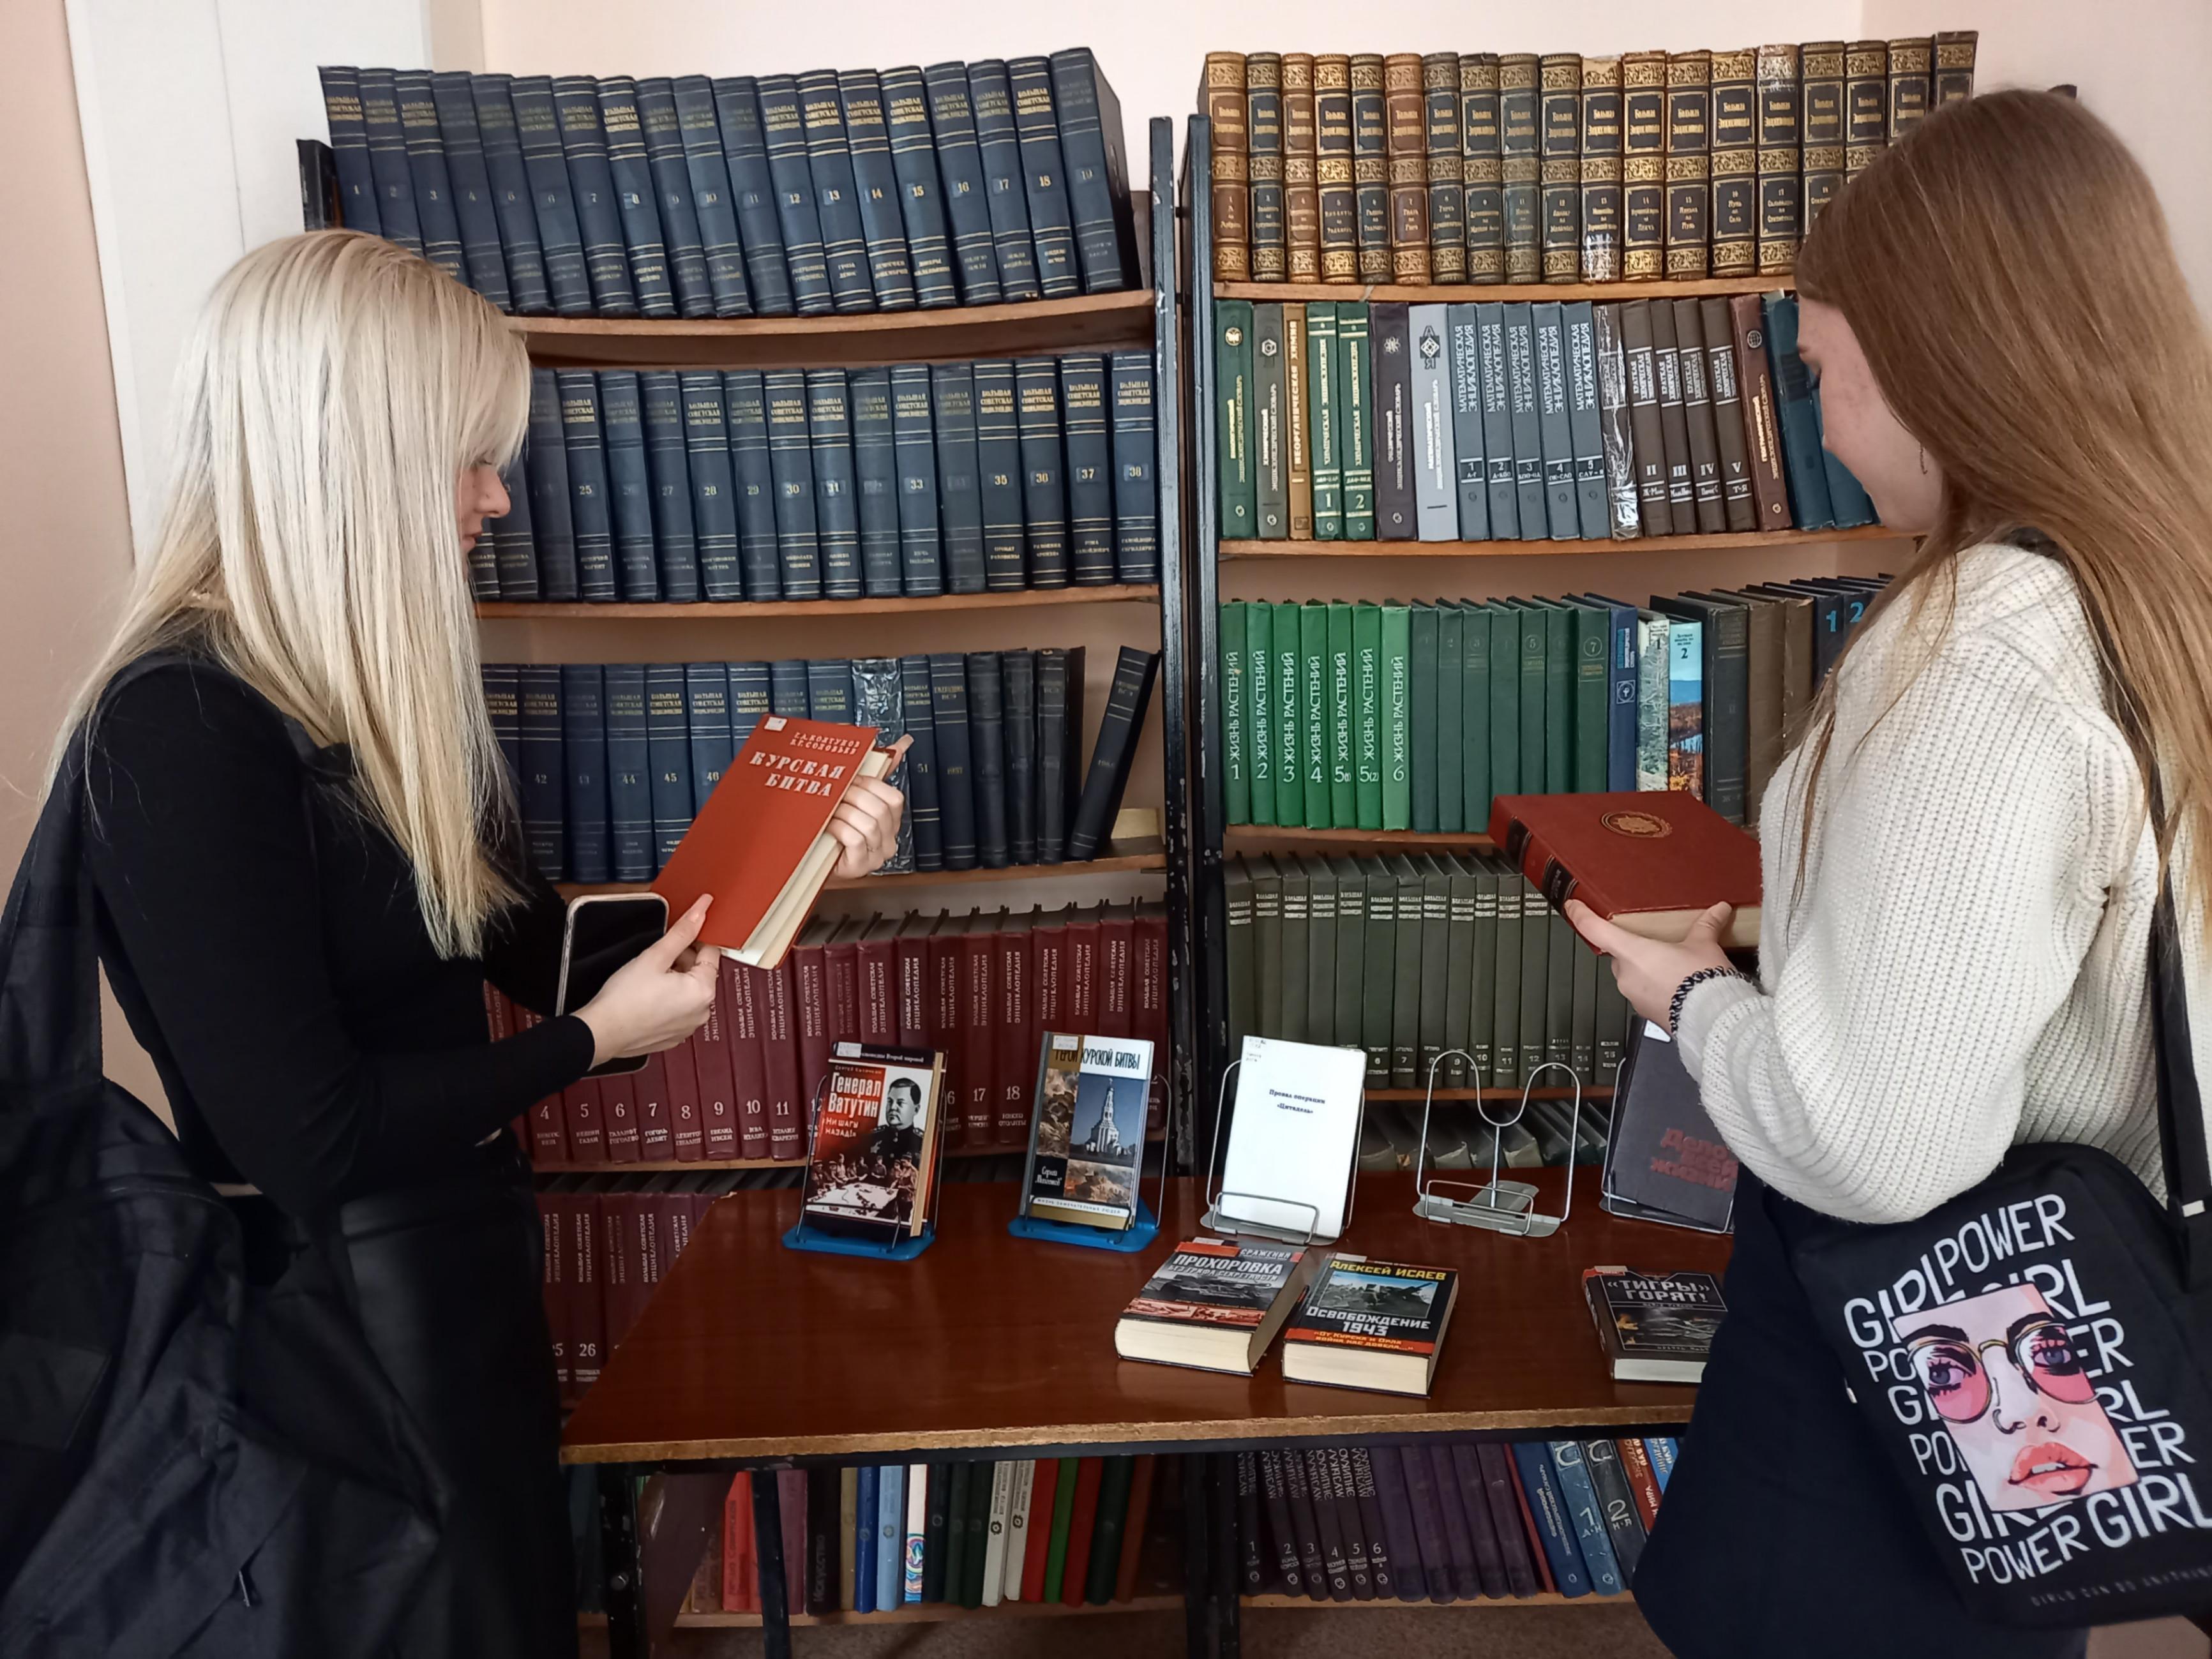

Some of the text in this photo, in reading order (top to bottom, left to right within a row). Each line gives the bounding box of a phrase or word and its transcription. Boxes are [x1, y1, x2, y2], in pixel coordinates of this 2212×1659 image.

[998, 179, 1009, 190] 17
[1039, 175, 1051, 187] 18
[790, 193, 801, 204] 12
[871, 188, 883, 199] 14
[912, 185, 924, 197] 15
[1454, 325, 1467, 412] МАТЕМАТИЧЕСКАЯ
[1464, 324, 1477, 412] ЭНЦИКЛОПЕДИЯ
[1482, 325, 1496, 412] МАТЕМАТИЧЕСКАЯ
[1491, 324, 1506, 412] ЭНЦИКЛОПЕДИЯ
[1509, 326, 1524, 414] МАТЕМАТИЧЕСКАЯ
[1519, 325, 1533, 412] ЭНЦИКЛОПЕДИЯ
[1539, 327, 1554, 414] МАТЕМАТИЧЕСКАЯ
[1548, 326, 1563, 413] ЭНЦИКЛОПЕДИЯ
[1570, 324, 1584, 411] МАТЕМАТИЧЕСКАЯ
[1579, 322, 1595, 410] ЭНЦИКЛОПЕДИЯ
[1129, 466, 1141, 477] 38
[1468, 462, 1474, 471] 1
[1498, 462, 1504, 470] 2
[1526, 463, 1533, 471] 3
[1556, 463, 1563, 472] 4
[1588, 460, 1593, 470] 5
[1646, 464, 1657, 476] II
[1673, 464, 1687, 477] III
[1701, 463, 1715, 476] IV
[1731, 462, 1741, 473] V
[1081, 468, 1094, 479] 37
[704, 486, 717, 496] 28
[786, 484, 800, 494] 30
[910, 479, 923, 490] 33
[1325, 493, 1332, 508] 1
[1355, 495, 1366, 509] 2
[1849, 601, 1864, 623] 2
[1826, 610, 1837, 632] 1
[1681, 648, 1688, 659] 2
[1226, 651, 1240, 761] ЖИЗНЬ РАСТЕНИЙ
[1253, 650, 1267, 760] ЖИЗНЬ РАСТЕНИЙ
[1281, 652, 1295, 764] ЖИЗНЬ РАСТЕНИЙ
[1308, 656, 1321, 765] ЖИЗНЬ РАСТЕНИЙ
[1334, 652, 1349, 762] ЖИЗНЬ РАСТЕНИЙ
[1360, 648, 1374, 760] ЖИЗНЬ РАСТЕНИЙ
[1391, 656, 1404, 763] ЖИЗНЬ РАСТЕНИЙ
[749, 751, 846, 779] КУРСКАЯ
[1231, 764, 1240, 779] 1
[1257, 762, 1268, 779] 2
[664, 773, 677, 783] 45
[1283, 766, 1295, 783] 3
[1310, 767, 1323, 783] 4
[1393, 765, 1404, 782] 6
[765, 773, 832, 797] БИТВА
[1080, 1047, 1113, 1067] КУРСКОЙ
[1115, 1051, 1141, 1070] БИТВЫ
[831, 1072, 882, 1098] Генерал
[974, 1088, 986, 1102] 17
[1006, 1086, 1020, 1100] 18
[1269, 1089, 1325, 1104] Провал операции
[580, 1103, 589, 1118] 5
[615, 1103, 625, 1117] 6
[649, 1103, 658, 1117] 7
[681, 1105, 691, 1120] 8
[714, 1102, 724, 1116] 9
[746, 1100, 760, 1115] 10
[776, 1101, 789, 1116] 11
[828, 1092, 878, 1118] Ватутин
[1934, 1194, 2075, 1286] POWER
[1240, 1248, 1291, 1261] СРАЖЕНИЯ
[1174, 1254, 1283, 1275] ПРОХОРОВКА
[1329, 1260, 1392, 1275] АЛЕКСЕЙ
[1396, 1267, 1447, 1280] ИСАЕВ
[1607, 1280, 1710, 1292] «ТИГРЫ»
[1625, 1290, 1708, 1303] ГОРЯТ!
[1342, 1321, 1388, 1337] 1943
[579, 1343, 596, 1357] 26
[1579, 1506, 1595, 1526] 1
[1607, 1499, 1630, 1522] 2
[1960, 1472, 2212, 1584] POWER GIRL
[1332, 1547, 1339, 1558] 4
[1352, 1543, 1360, 1554] 5
[1373, 1542, 1381, 1554] 6
